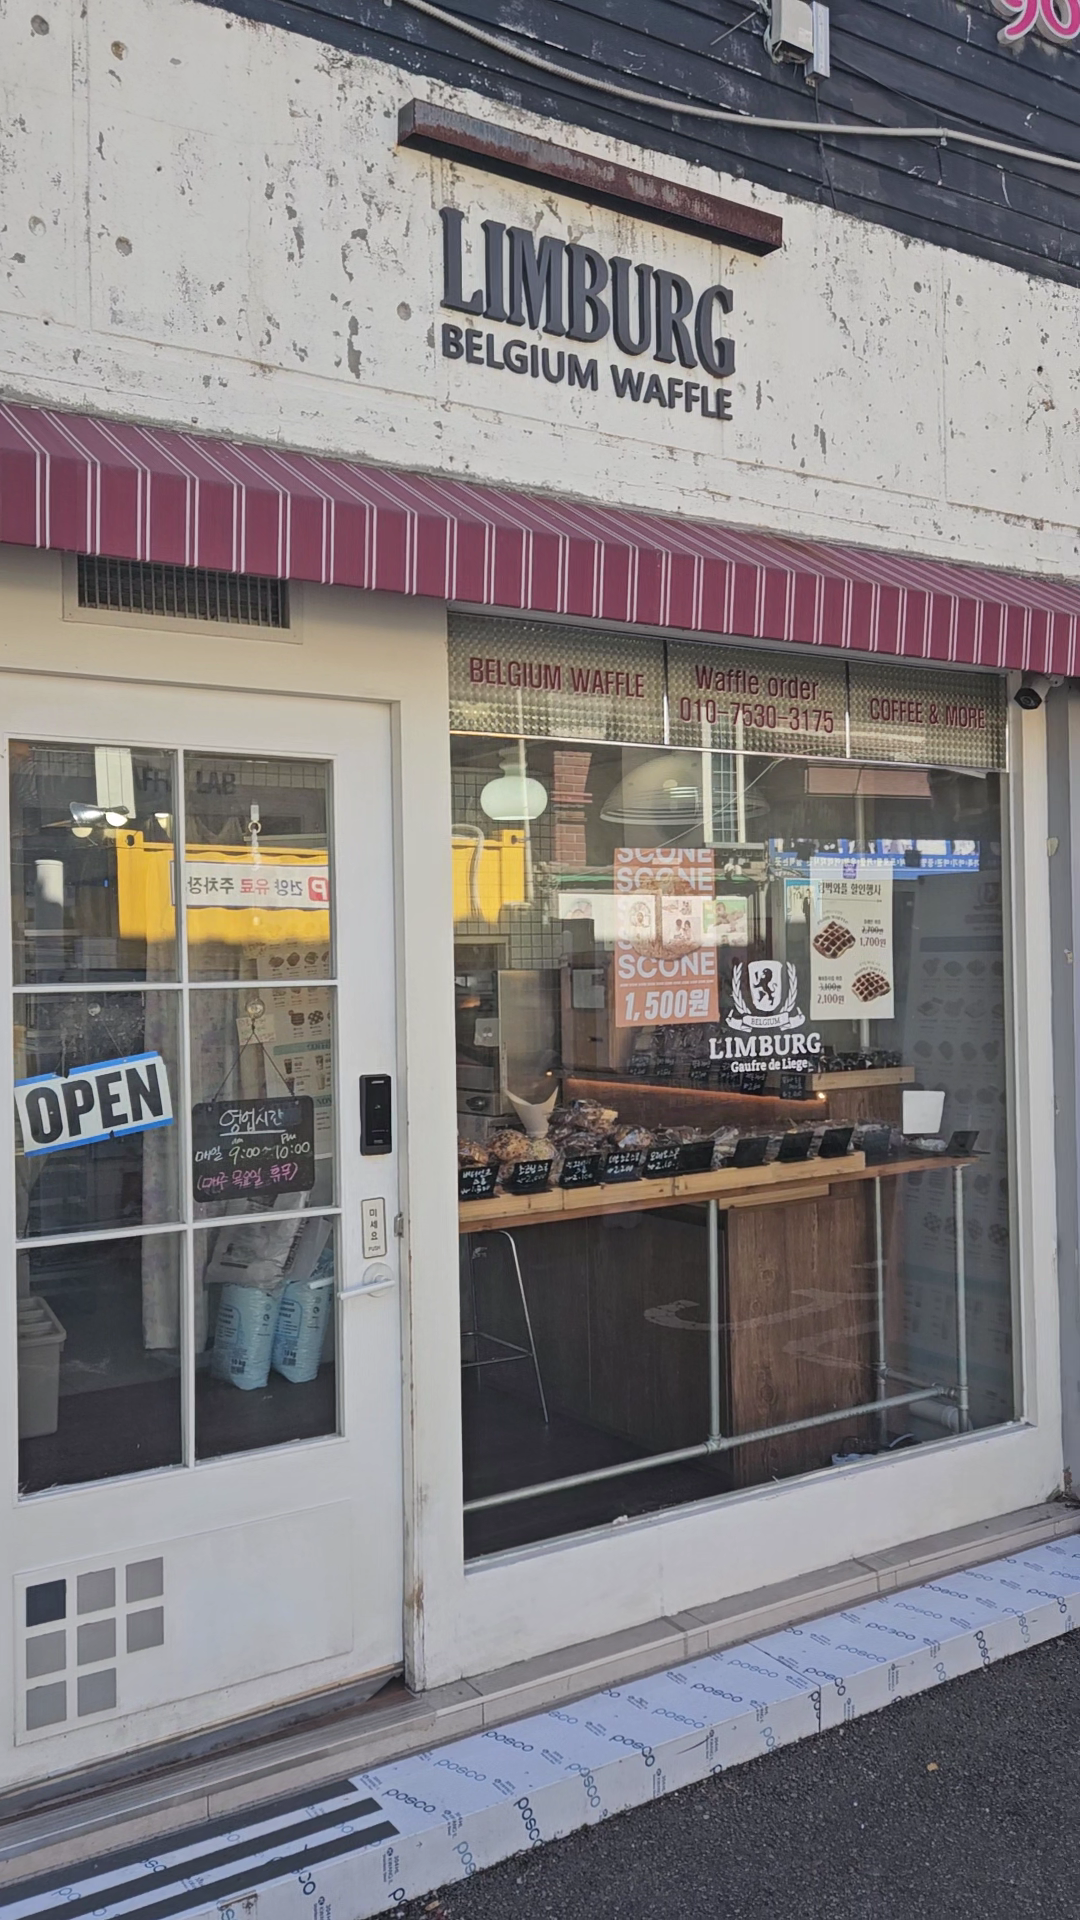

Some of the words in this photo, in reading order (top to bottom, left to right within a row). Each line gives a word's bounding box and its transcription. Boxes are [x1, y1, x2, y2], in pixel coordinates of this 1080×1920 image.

[440, 206, 736, 379] LIMBURG
[441, 322, 598, 391] BELGIUM
[610, 363, 734, 421] WAFFLE
[469, 657, 562, 690] BELGIUM
[570, 667, 645, 699] WAFFLE
[695, 664, 759, 697] Waffle
[767, 674, 819, 702] order
[680, 698, 835, 735] 010-7530-3175
[869, 698, 923, 726] COFFEE
[928, 705, 939, 726] &
[945, 704, 986, 731] MORE
[616, 848, 713, 865] SCONE
[850, 883, 882, 896] 할인행사
[859, 937, 887, 948] 1,700원
[618, 951, 716, 980] SCONE
[624, 988, 711, 1022] 1,500원
[817, 994, 845, 1005] 2,100원
[750, 1016, 781, 1027] BELGIUM
[708, 1032, 822, 1060] LIMBURG
[730, 1060, 767, 1073] Gaufre
[768, 1058, 781, 1071] de
[782, 1058, 808, 1072] Liege
[24, 1063, 165, 1144] OPEN
[219, 1107, 284, 1133] 영업시간
[195, 1146, 224, 1162] 매일
[197, 1172, 229, 1191] (매주
[231, 1168, 264, 1190] 목요일
[369, 1208, 378, 1241] 미세요
[894, 1602, 943, 1620] posco
[1026, 1588, 1067, 1614] posco
[835, 1644, 887, 1663] posco
[727, 1659, 779, 1678] posco
[690, 1683, 743, 1703] posco
[803, 1667, 846, 1696] posco
[651, 1708, 705, 1729] posco
[481, 1731, 534, 1753] posco
[609, 1734, 656, 1767] posco
[433, 1758, 487, 1782] posco
[565, 1762, 601, 1808] posco
[382, 1788, 436, 1813] posco
